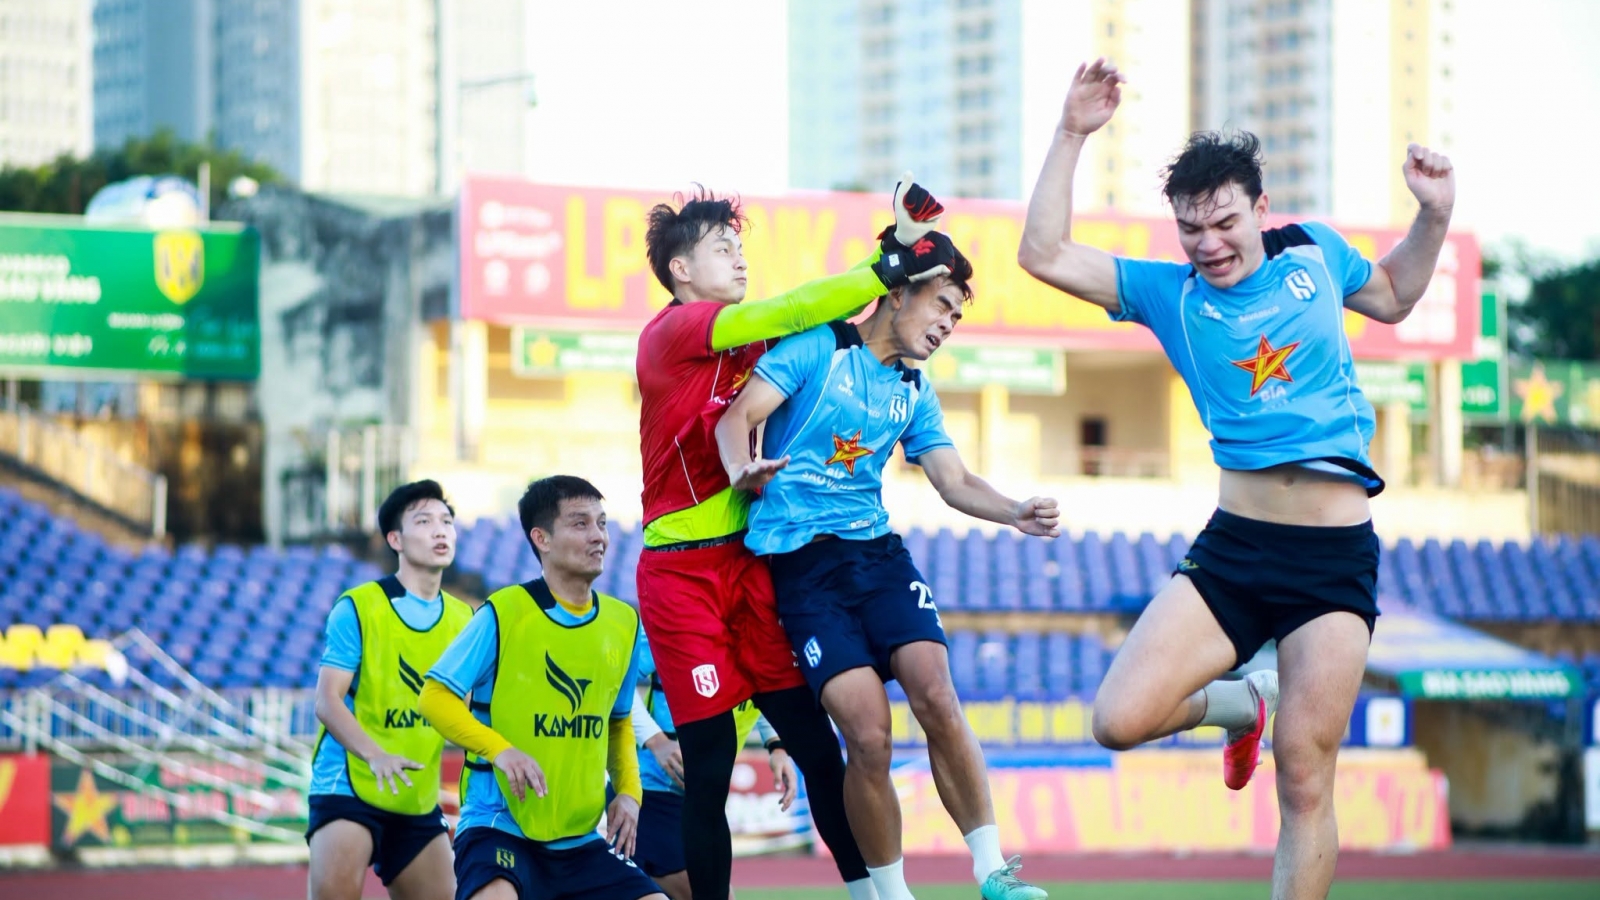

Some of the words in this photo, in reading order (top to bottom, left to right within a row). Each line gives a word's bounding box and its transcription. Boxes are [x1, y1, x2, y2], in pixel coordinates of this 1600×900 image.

[565, 196, 835, 312] LPNK
[384, 708, 431, 729] KAM
[534, 713, 604, 740] KAMITO
